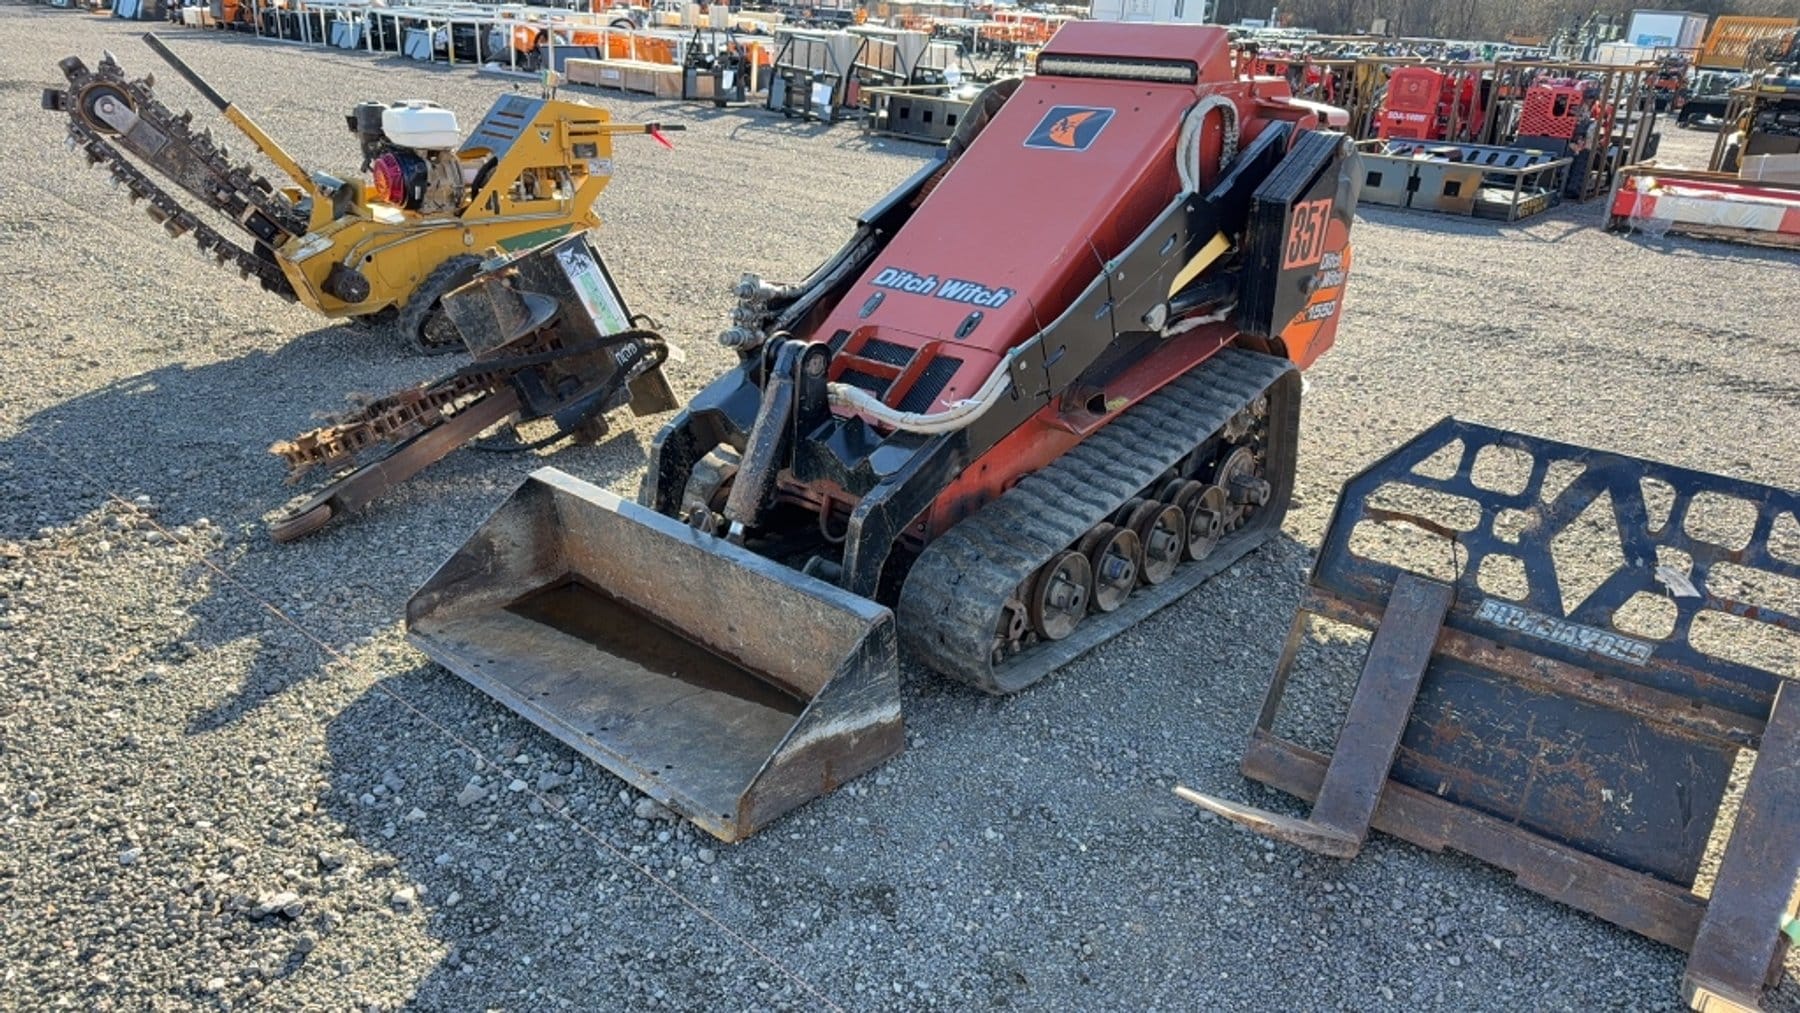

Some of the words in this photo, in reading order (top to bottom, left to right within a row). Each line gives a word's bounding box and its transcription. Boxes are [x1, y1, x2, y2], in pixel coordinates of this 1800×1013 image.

[1288, 203, 1329, 264] 351
[870, 266, 938, 295] Ditch
[935, 279, 1012, 308] Witch
